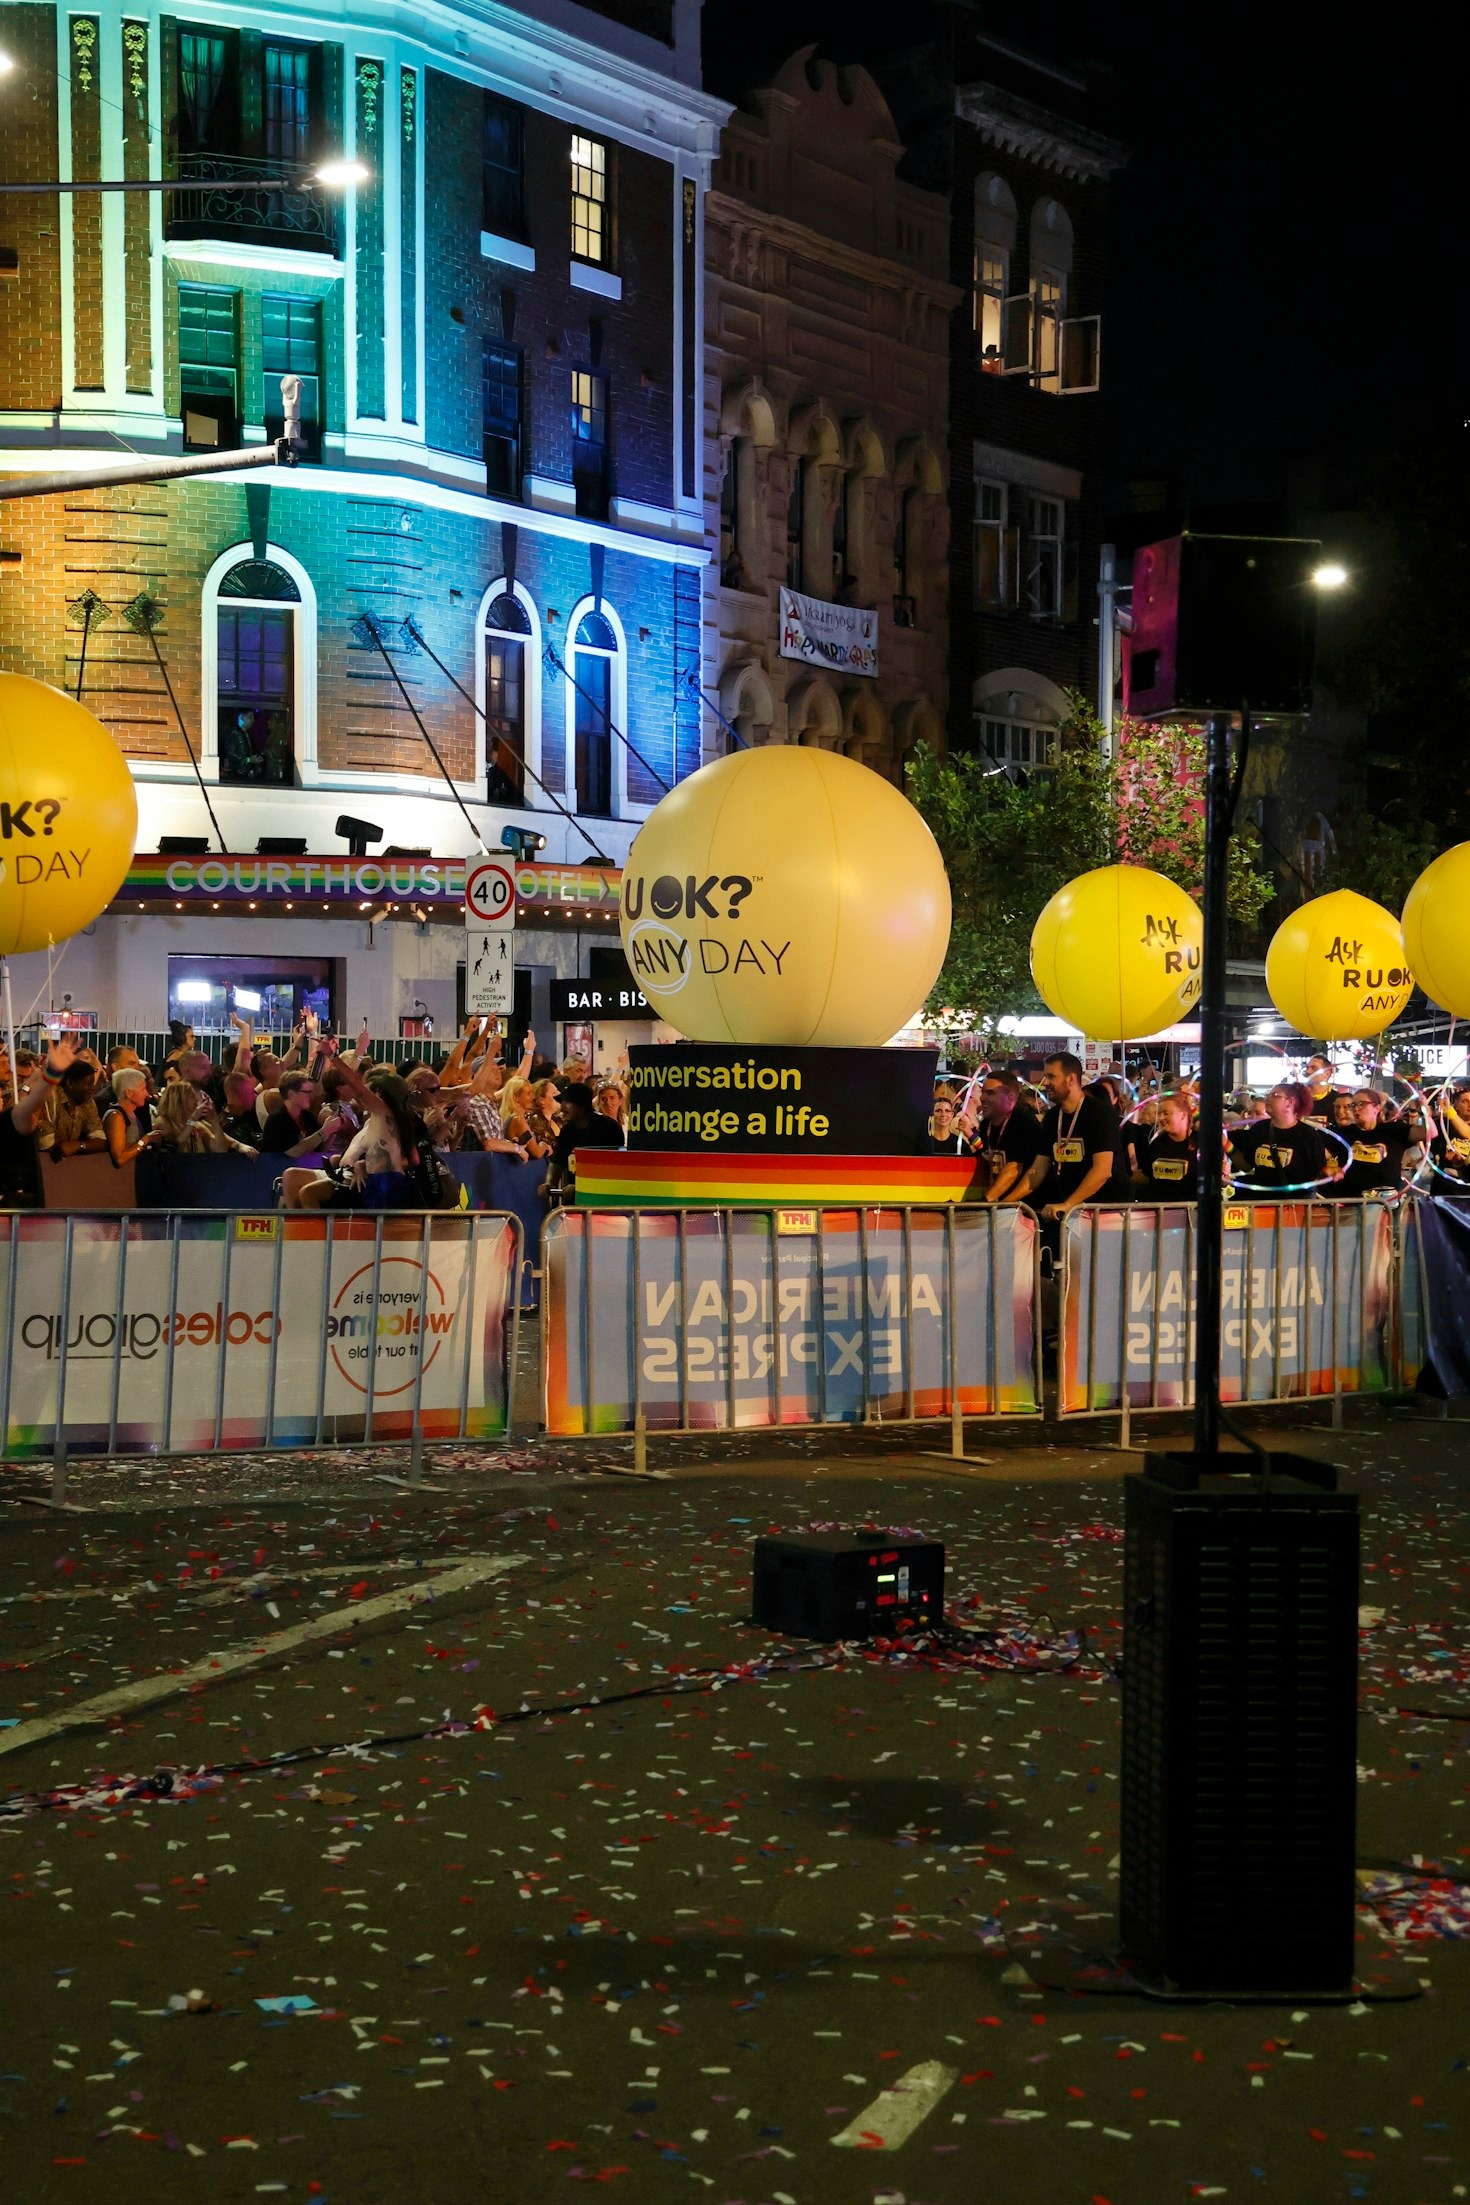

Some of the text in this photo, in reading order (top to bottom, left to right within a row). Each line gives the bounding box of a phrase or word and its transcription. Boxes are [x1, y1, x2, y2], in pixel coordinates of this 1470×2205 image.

[16, 848, 91, 884] DAY
[166, 860, 590, 902] COURTHOUSE OTEL
[474, 880, 507, 904] 40
[632, 939, 791, 975] ANY DAY
[568, 992, 602, 1008] BAR
[1181, 978, 1201, 999] AN
[1361, 994, 1400, 1010] ANY
[629, 1059, 802, 1090] conversation
[644, 1102, 739, 1141] change
[746, 1112, 766, 1135] a
[775, 1105, 829, 1137] life
